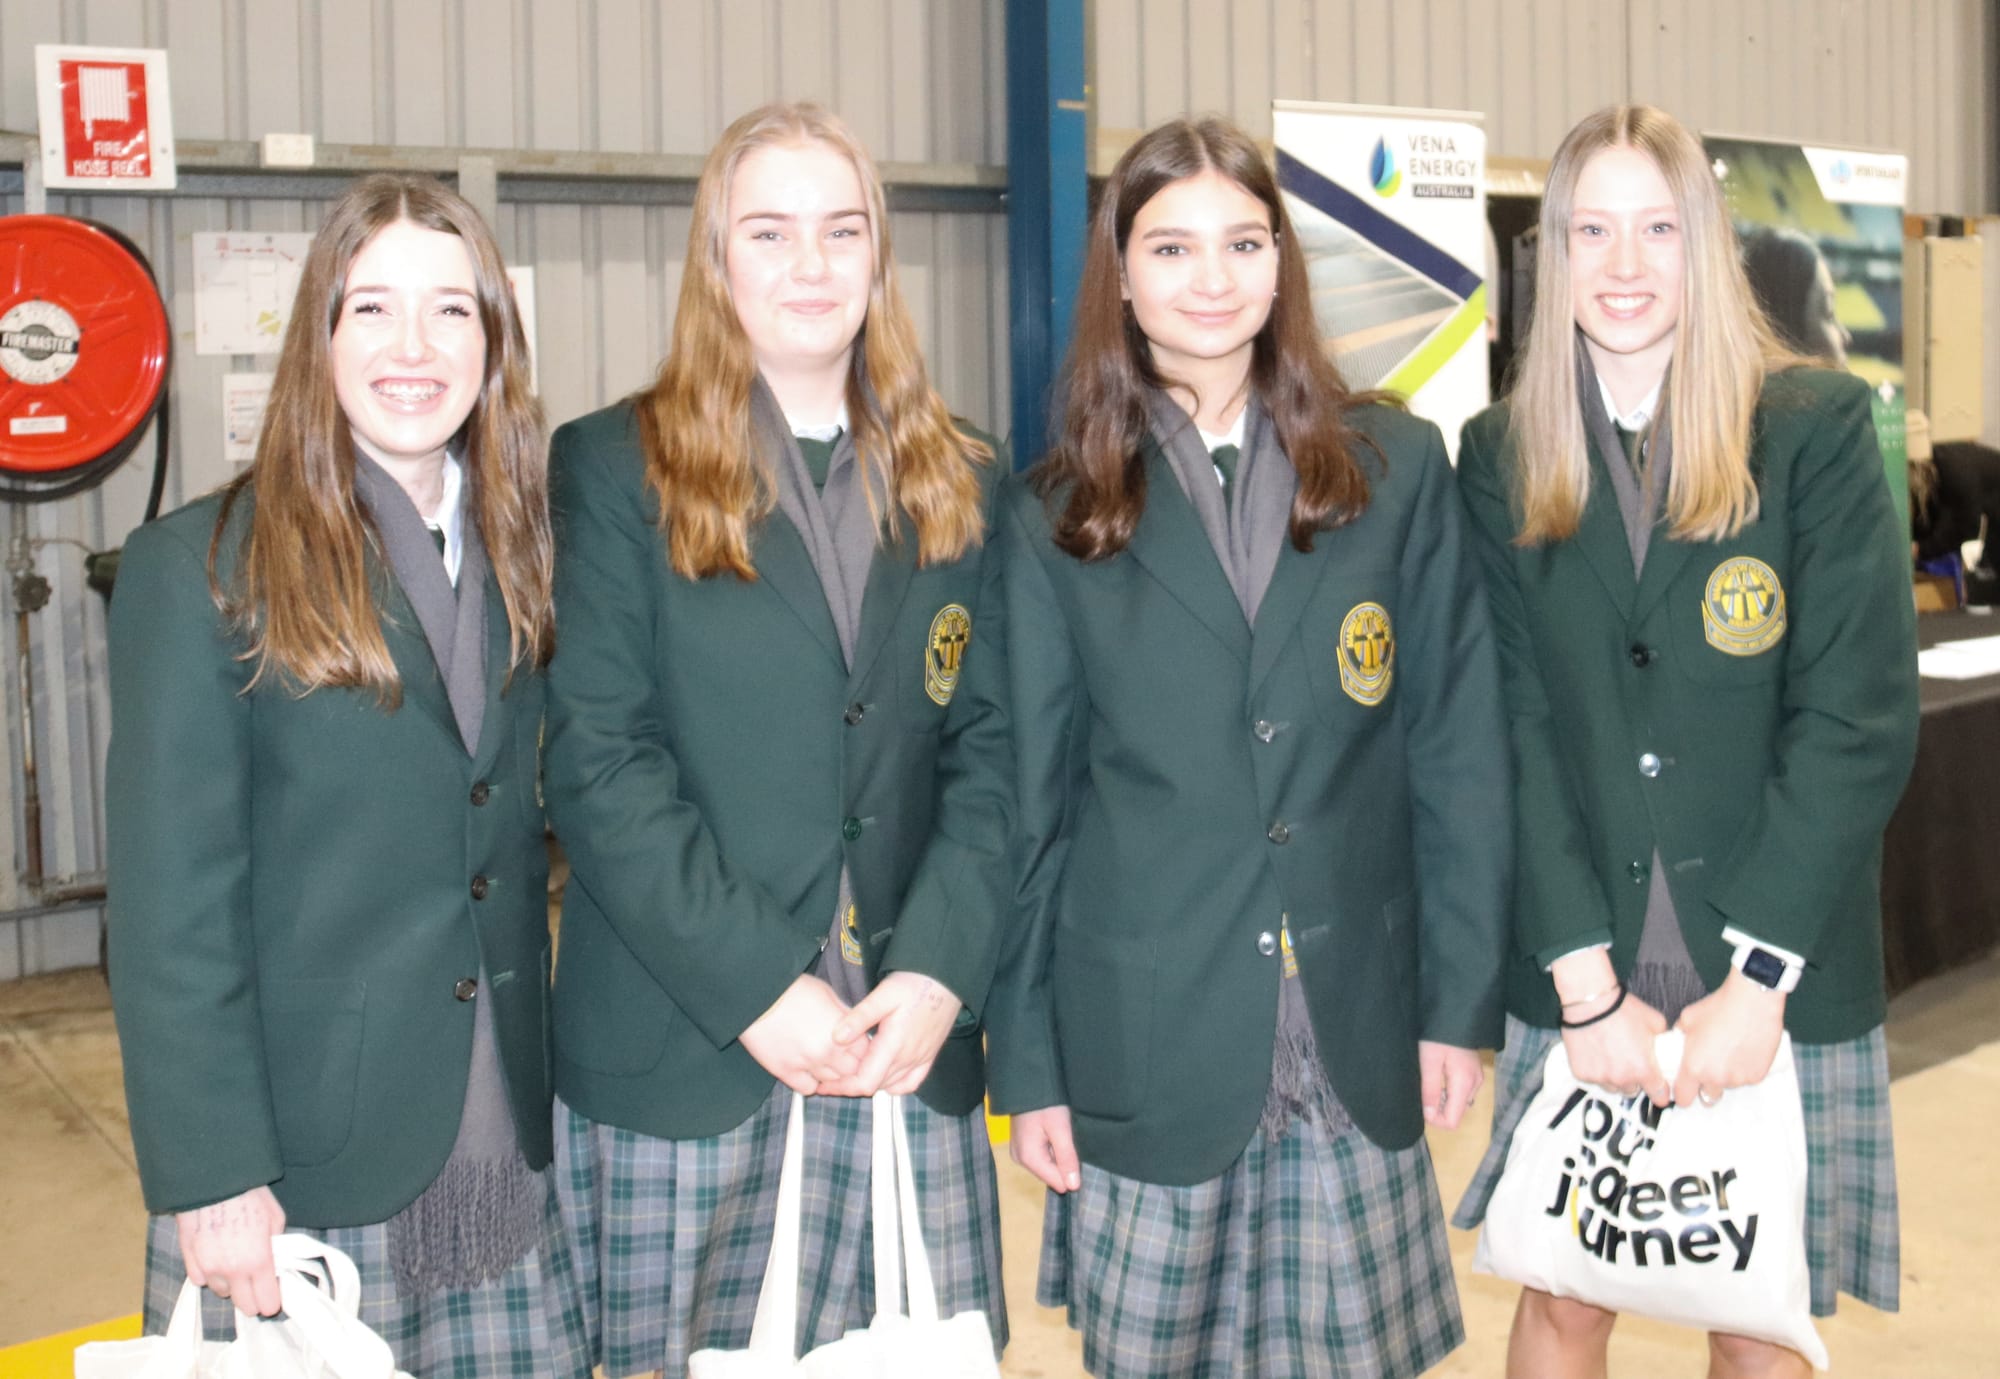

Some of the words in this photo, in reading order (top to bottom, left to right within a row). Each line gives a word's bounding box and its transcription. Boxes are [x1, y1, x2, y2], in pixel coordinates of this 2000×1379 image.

[93, 141, 124, 157] FIRE
[1408, 134, 1456, 153] VENA
[73, 160, 109, 176] HOSE
[111, 160, 146, 176] REEL
[1409, 158, 1477, 177] ENERGY
[1415, 184, 1472, 197] AUSTRALIA
[2, 332, 73, 353] FIREMASTER
